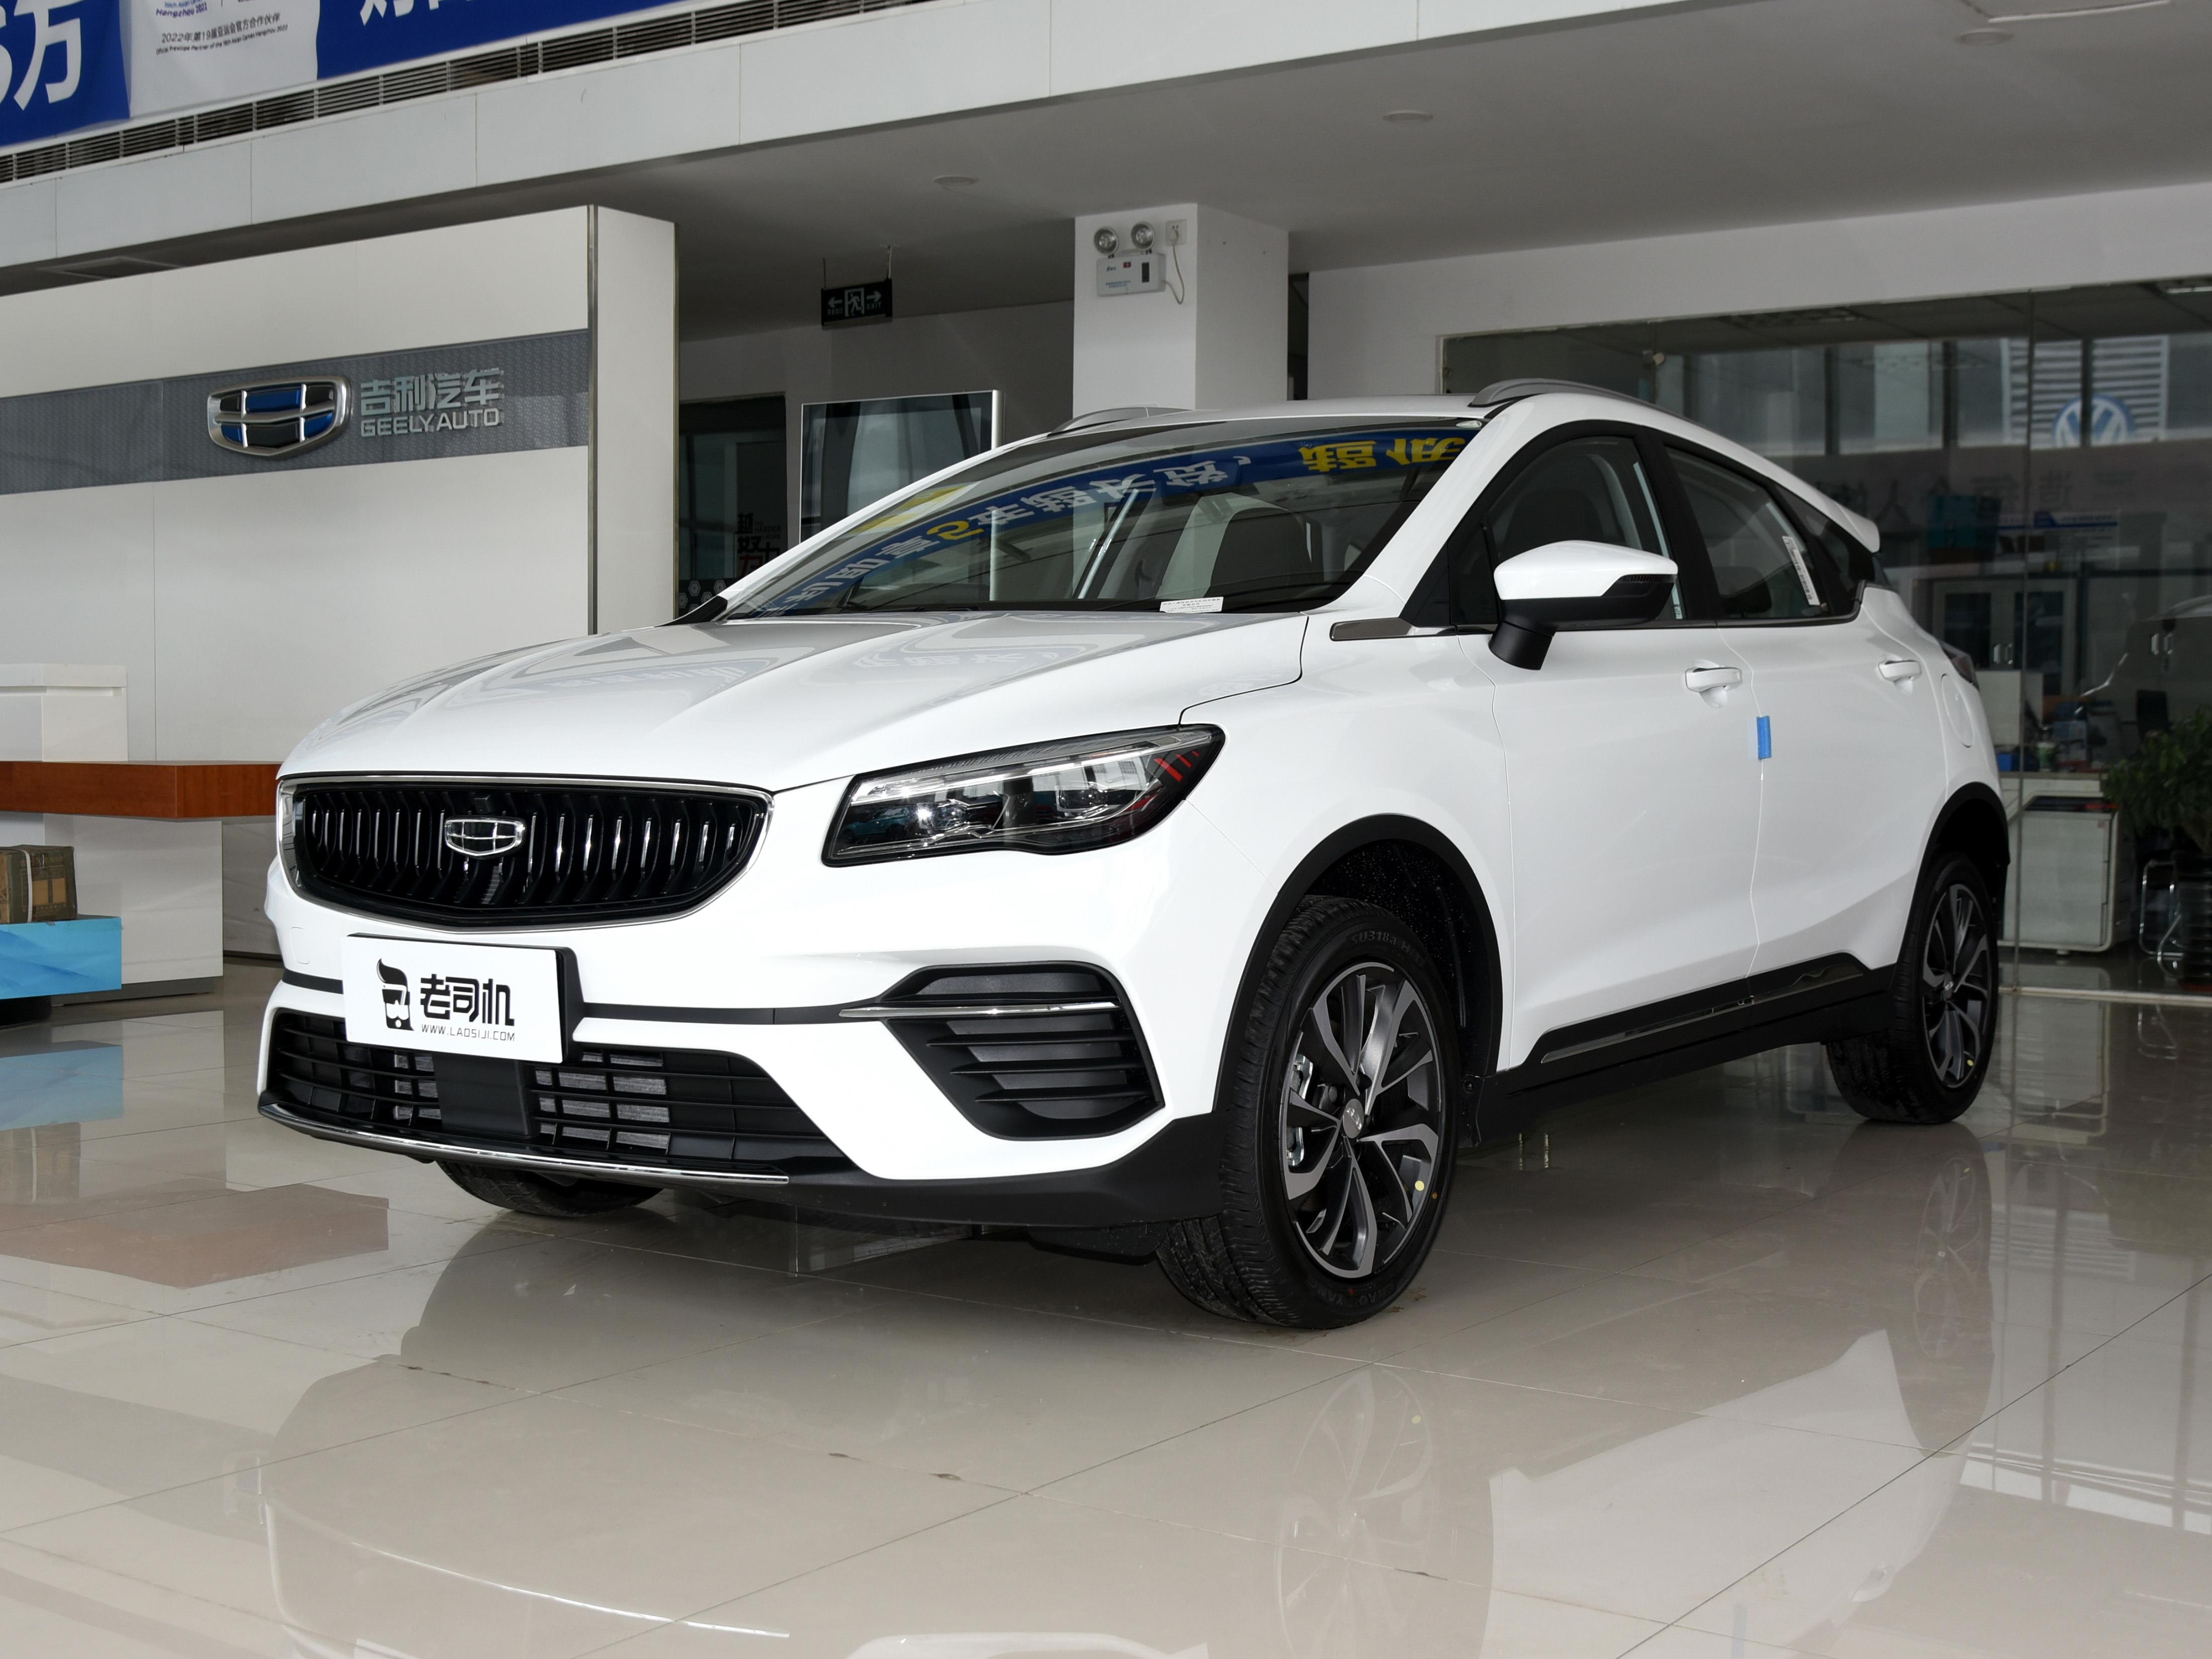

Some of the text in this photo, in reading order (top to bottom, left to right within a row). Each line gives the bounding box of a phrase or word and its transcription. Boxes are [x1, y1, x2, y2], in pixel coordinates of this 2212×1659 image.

[156, 2, 208, 18] Hangzhou 2022
[360, 367, 501, 416] 吉利汽车
[420, 973, 515, 1026] 老司机
[421, 1023, 516, 1042] WWW.LAOSIJI.COM
